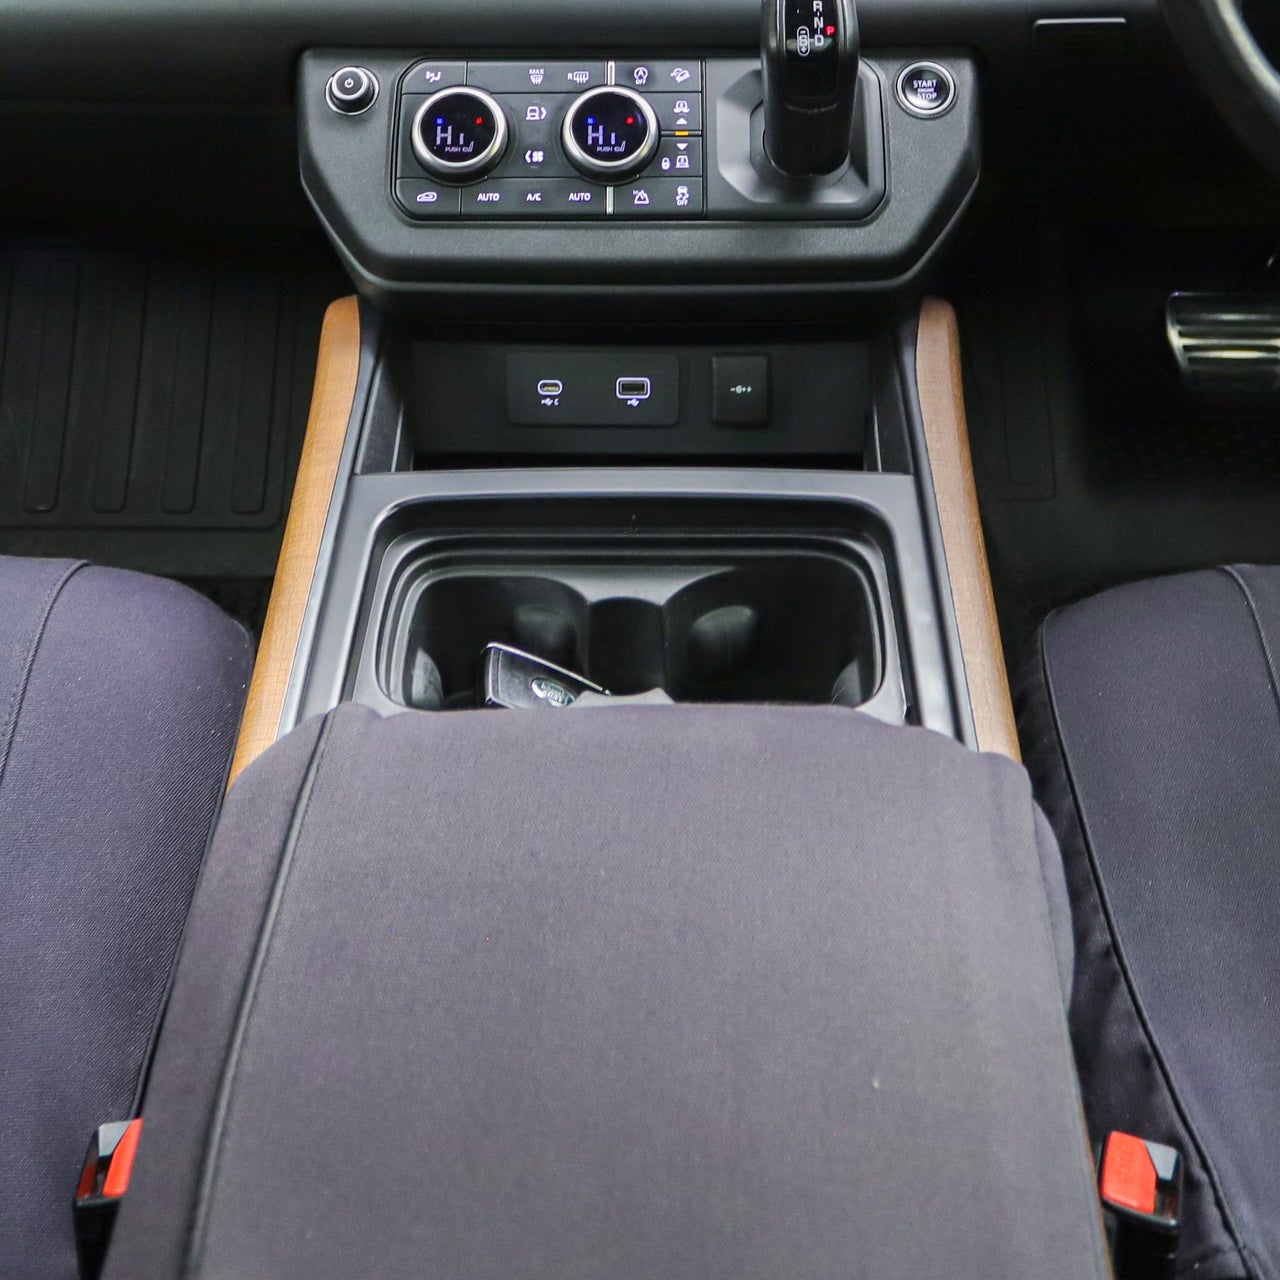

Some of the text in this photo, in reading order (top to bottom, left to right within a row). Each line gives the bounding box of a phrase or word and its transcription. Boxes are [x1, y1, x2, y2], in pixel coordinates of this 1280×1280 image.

[813, 0, 823, 12] R
[813, 17, 824, 28] N
[827, 26, 834, 35] P
[814, 35, 824, 47] D
[913, 79, 937, 88] START
[477, 193, 500, 202] AUTO
[526, 193, 542, 202] A/C
[568, 193, 591, 201] AUTO
